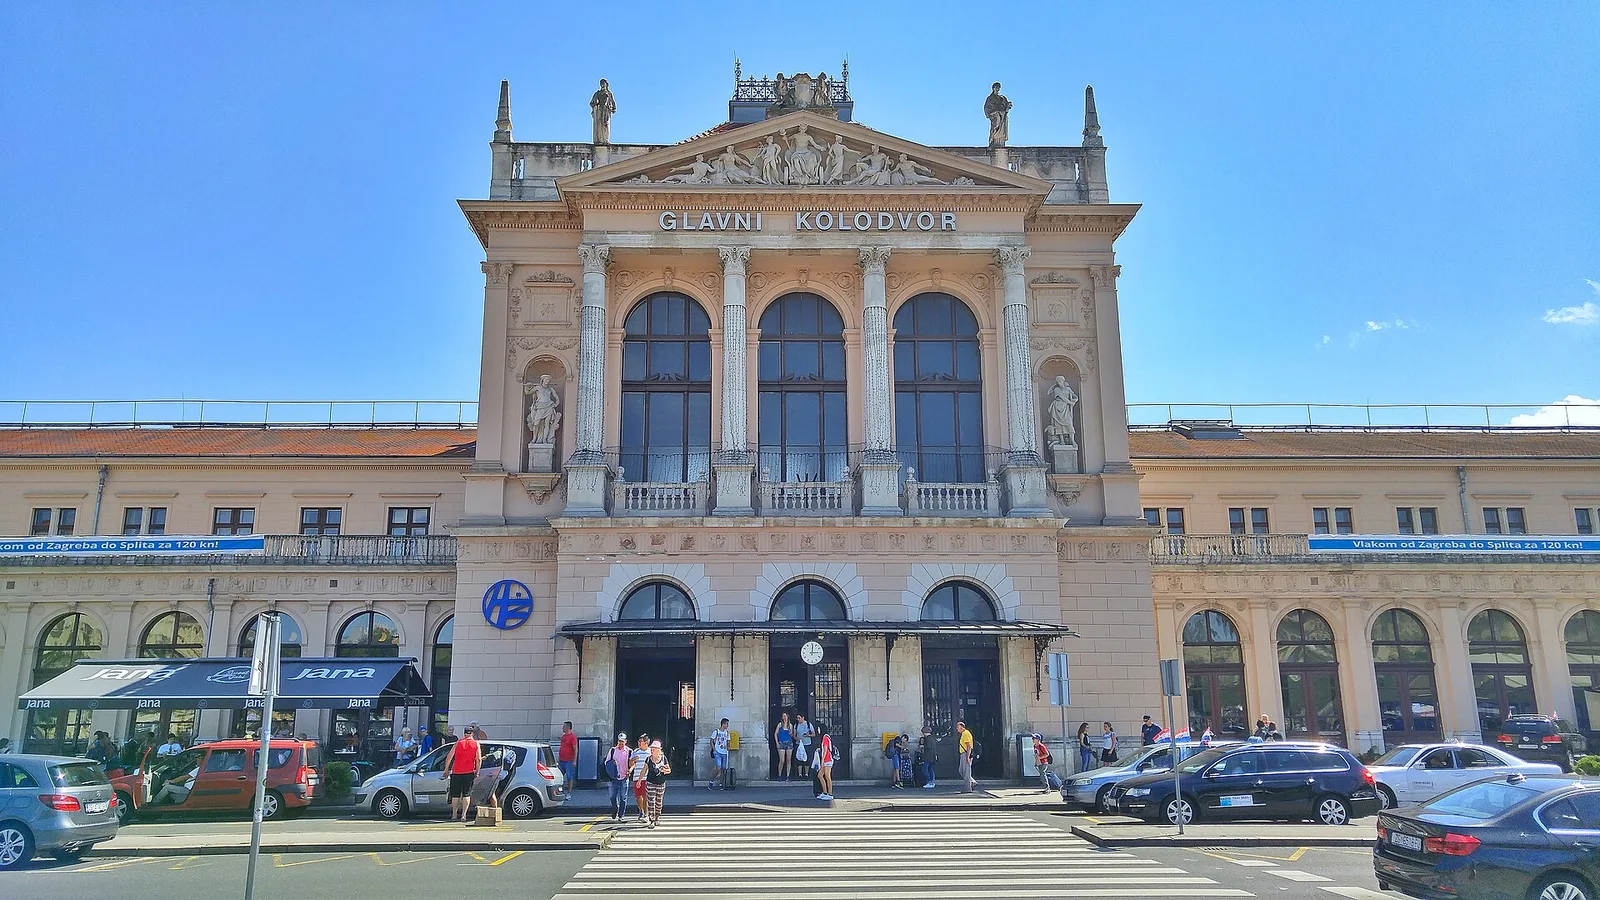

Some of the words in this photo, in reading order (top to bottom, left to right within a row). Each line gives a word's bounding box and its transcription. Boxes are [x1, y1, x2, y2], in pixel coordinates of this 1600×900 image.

[658, 211, 763, 231] GLAVNI
[796, 211, 957, 231] KOLODVOR
[27, 542, 44, 550] od
[46, 541, 98, 551] Zagreba
[101, 541, 117, 549] do
[119, 541, 155, 551] Splita
[176, 541, 197, 549] 120
[200, 540, 219, 549] kn!
[1352, 540, 1397, 548] Vlakom
[1400, 540, 1416, 549] od
[1417, 540, 1467, 550] Zagreba
[1469, 541, 1484, 549] do
[1487, 541, 1521, 550] Splita
[1541, 541, 1561, 549] 120
[1564, 541, 1583, 549] kn!
[25, 699, 50, 709] Jana
[136, 699, 161, 709] Jana
[347, 698, 371, 709] Jana
